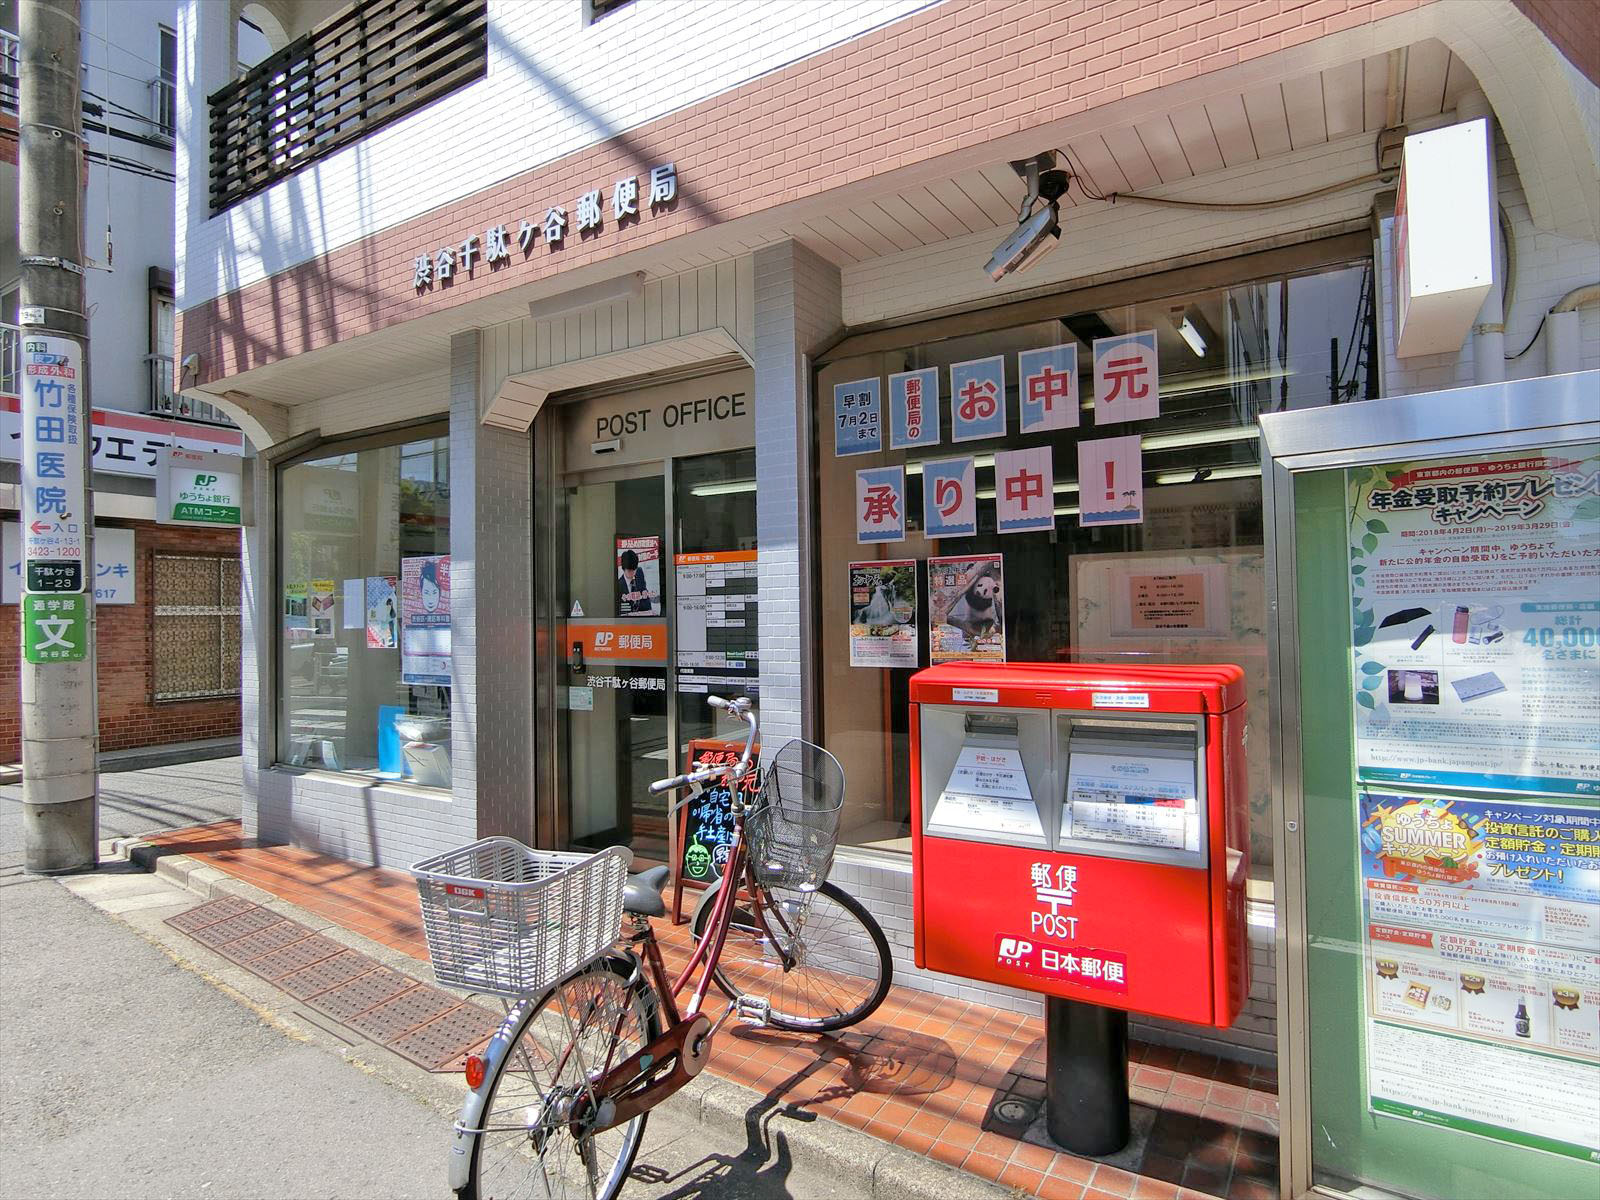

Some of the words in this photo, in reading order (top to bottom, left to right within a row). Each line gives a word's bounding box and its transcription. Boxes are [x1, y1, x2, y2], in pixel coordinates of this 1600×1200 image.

[28, 365, 74, 378] 形成外科
[843, 391, 872, 408] 早割
[597, 409, 651, 439] POST
[663, 392, 747, 428] OFFICE
[905, 378, 921, 440] 郵便局の
[837, 411, 879, 427] 7月2日
[857, 427, 878, 440] まで
[34, 379, 66, 514] 竹田医院
[179, 492, 230, 504] ゆうちょ銀行
[1371, 474, 1600, 510] 年金受取予約プレゼン
[180, 506, 236, 517] ATMコーナー
[1436, 500, 1541, 523] キャンペーン
[53, 523, 78, 533] 入口
[28, 547, 80, 557] 3423-1200
[37, 579, 72, 588] 1-23
[33, 599, 75, 611] 通学路
[618, 634, 653, 649] 郵便局
[1522, 627, 1600, 649] 40,00
[1542, 649, 1596, 661] 名さまに
[1396, 813, 1453, 831] ゆうちょ
[1484, 809, 1600, 827] キャンペーン対象期間中
[1382, 826, 1466, 850] SUMMER
[1484, 821, 1600, 842] 投資信託のご購入
[1382, 842, 1468, 862] キャンペーン
[1485, 850, 1600, 871] お預け入れいただいたお
[1031, 862, 1078, 893] 郵便
[1486, 862, 1565, 884] プレゼント!
[1374, 892, 1470, 911] 投資信託を50万円以上
[1031, 911, 1079, 940] POST
[997, 957, 1030, 968] POST
[1042, 949, 1124, 984] 日本郵便
